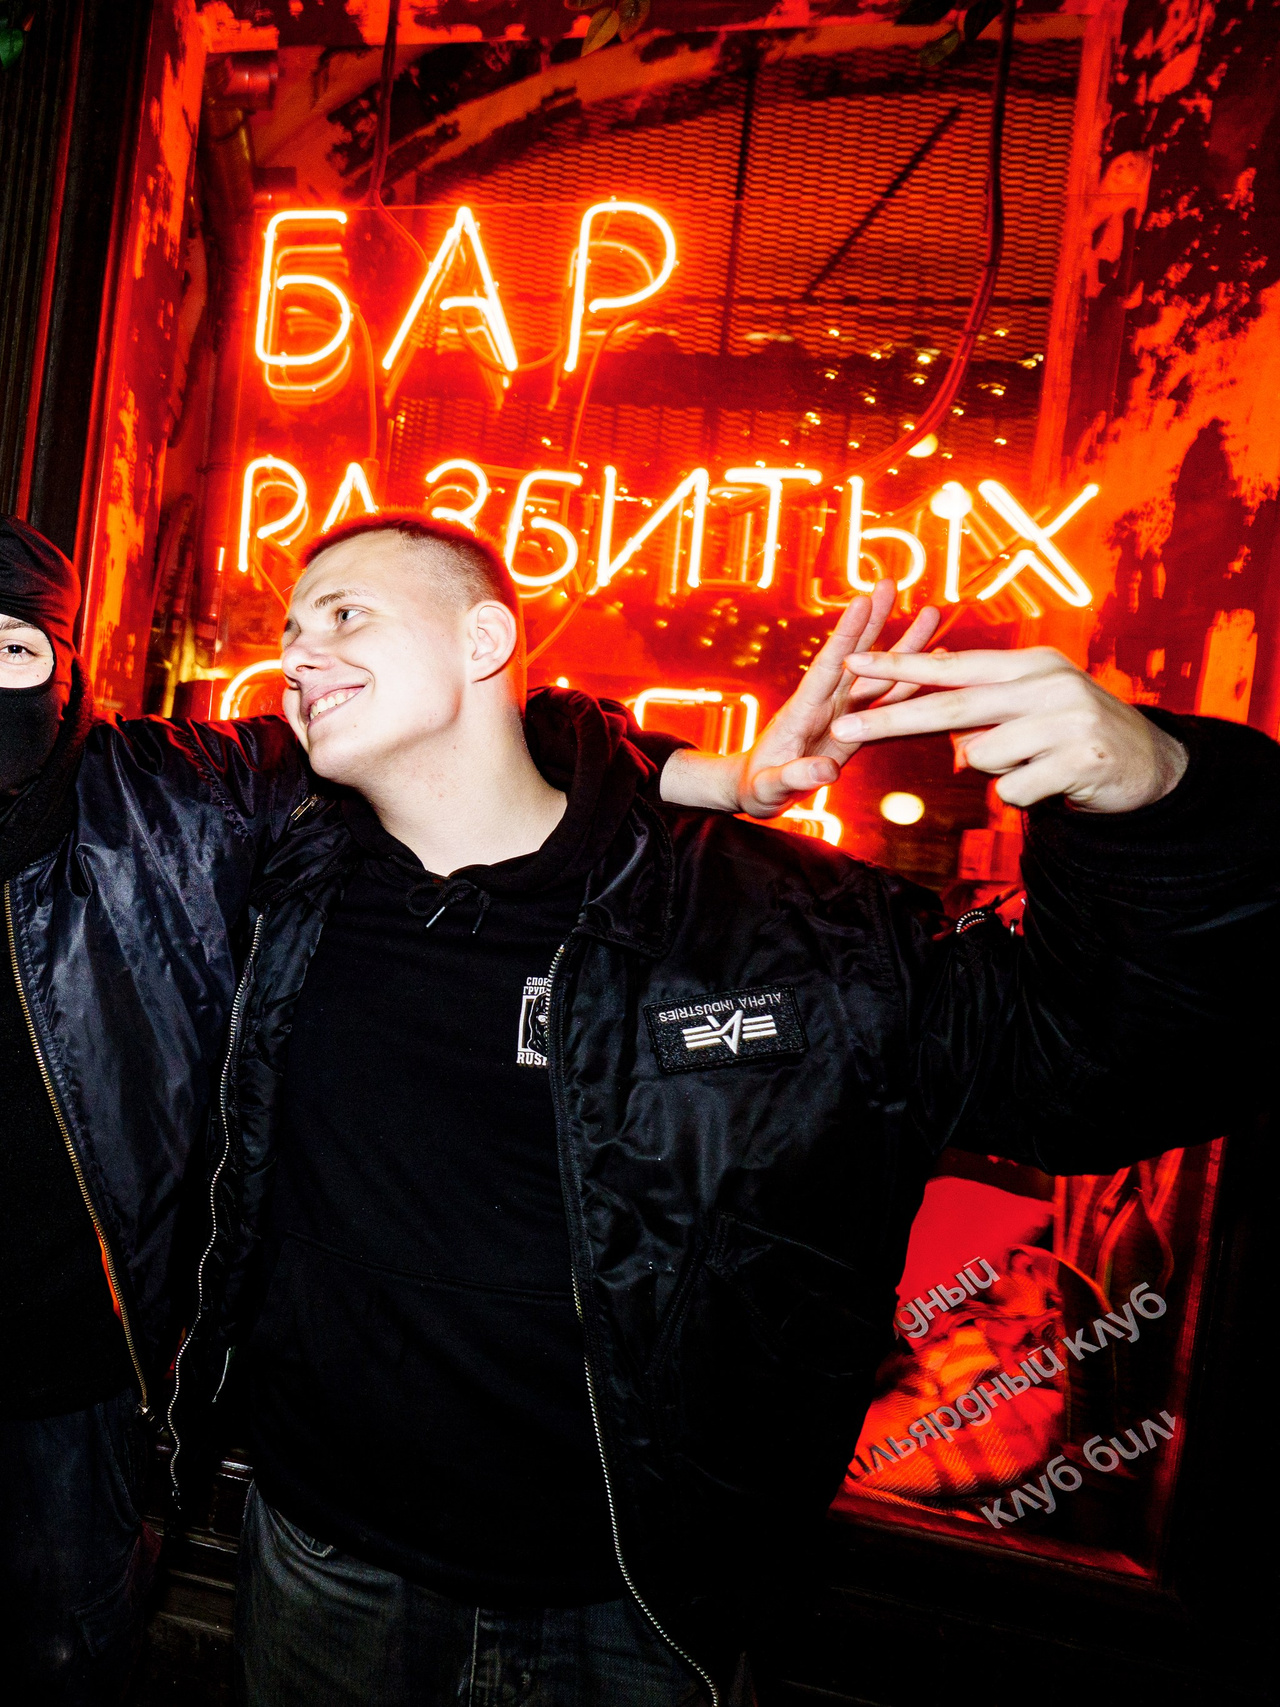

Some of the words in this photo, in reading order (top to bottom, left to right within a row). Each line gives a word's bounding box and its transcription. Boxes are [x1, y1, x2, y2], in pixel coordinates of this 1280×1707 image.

[253, 197, 680, 374] БАР
[658, 999, 735, 1023] INDUSTRIES
[738, 991, 782, 1009] ALPHA
[894, 1255, 1001, 1341] дный
[1062, 1281, 1168, 1362] клуб
[980, 1454, 1083, 1530] клуб
